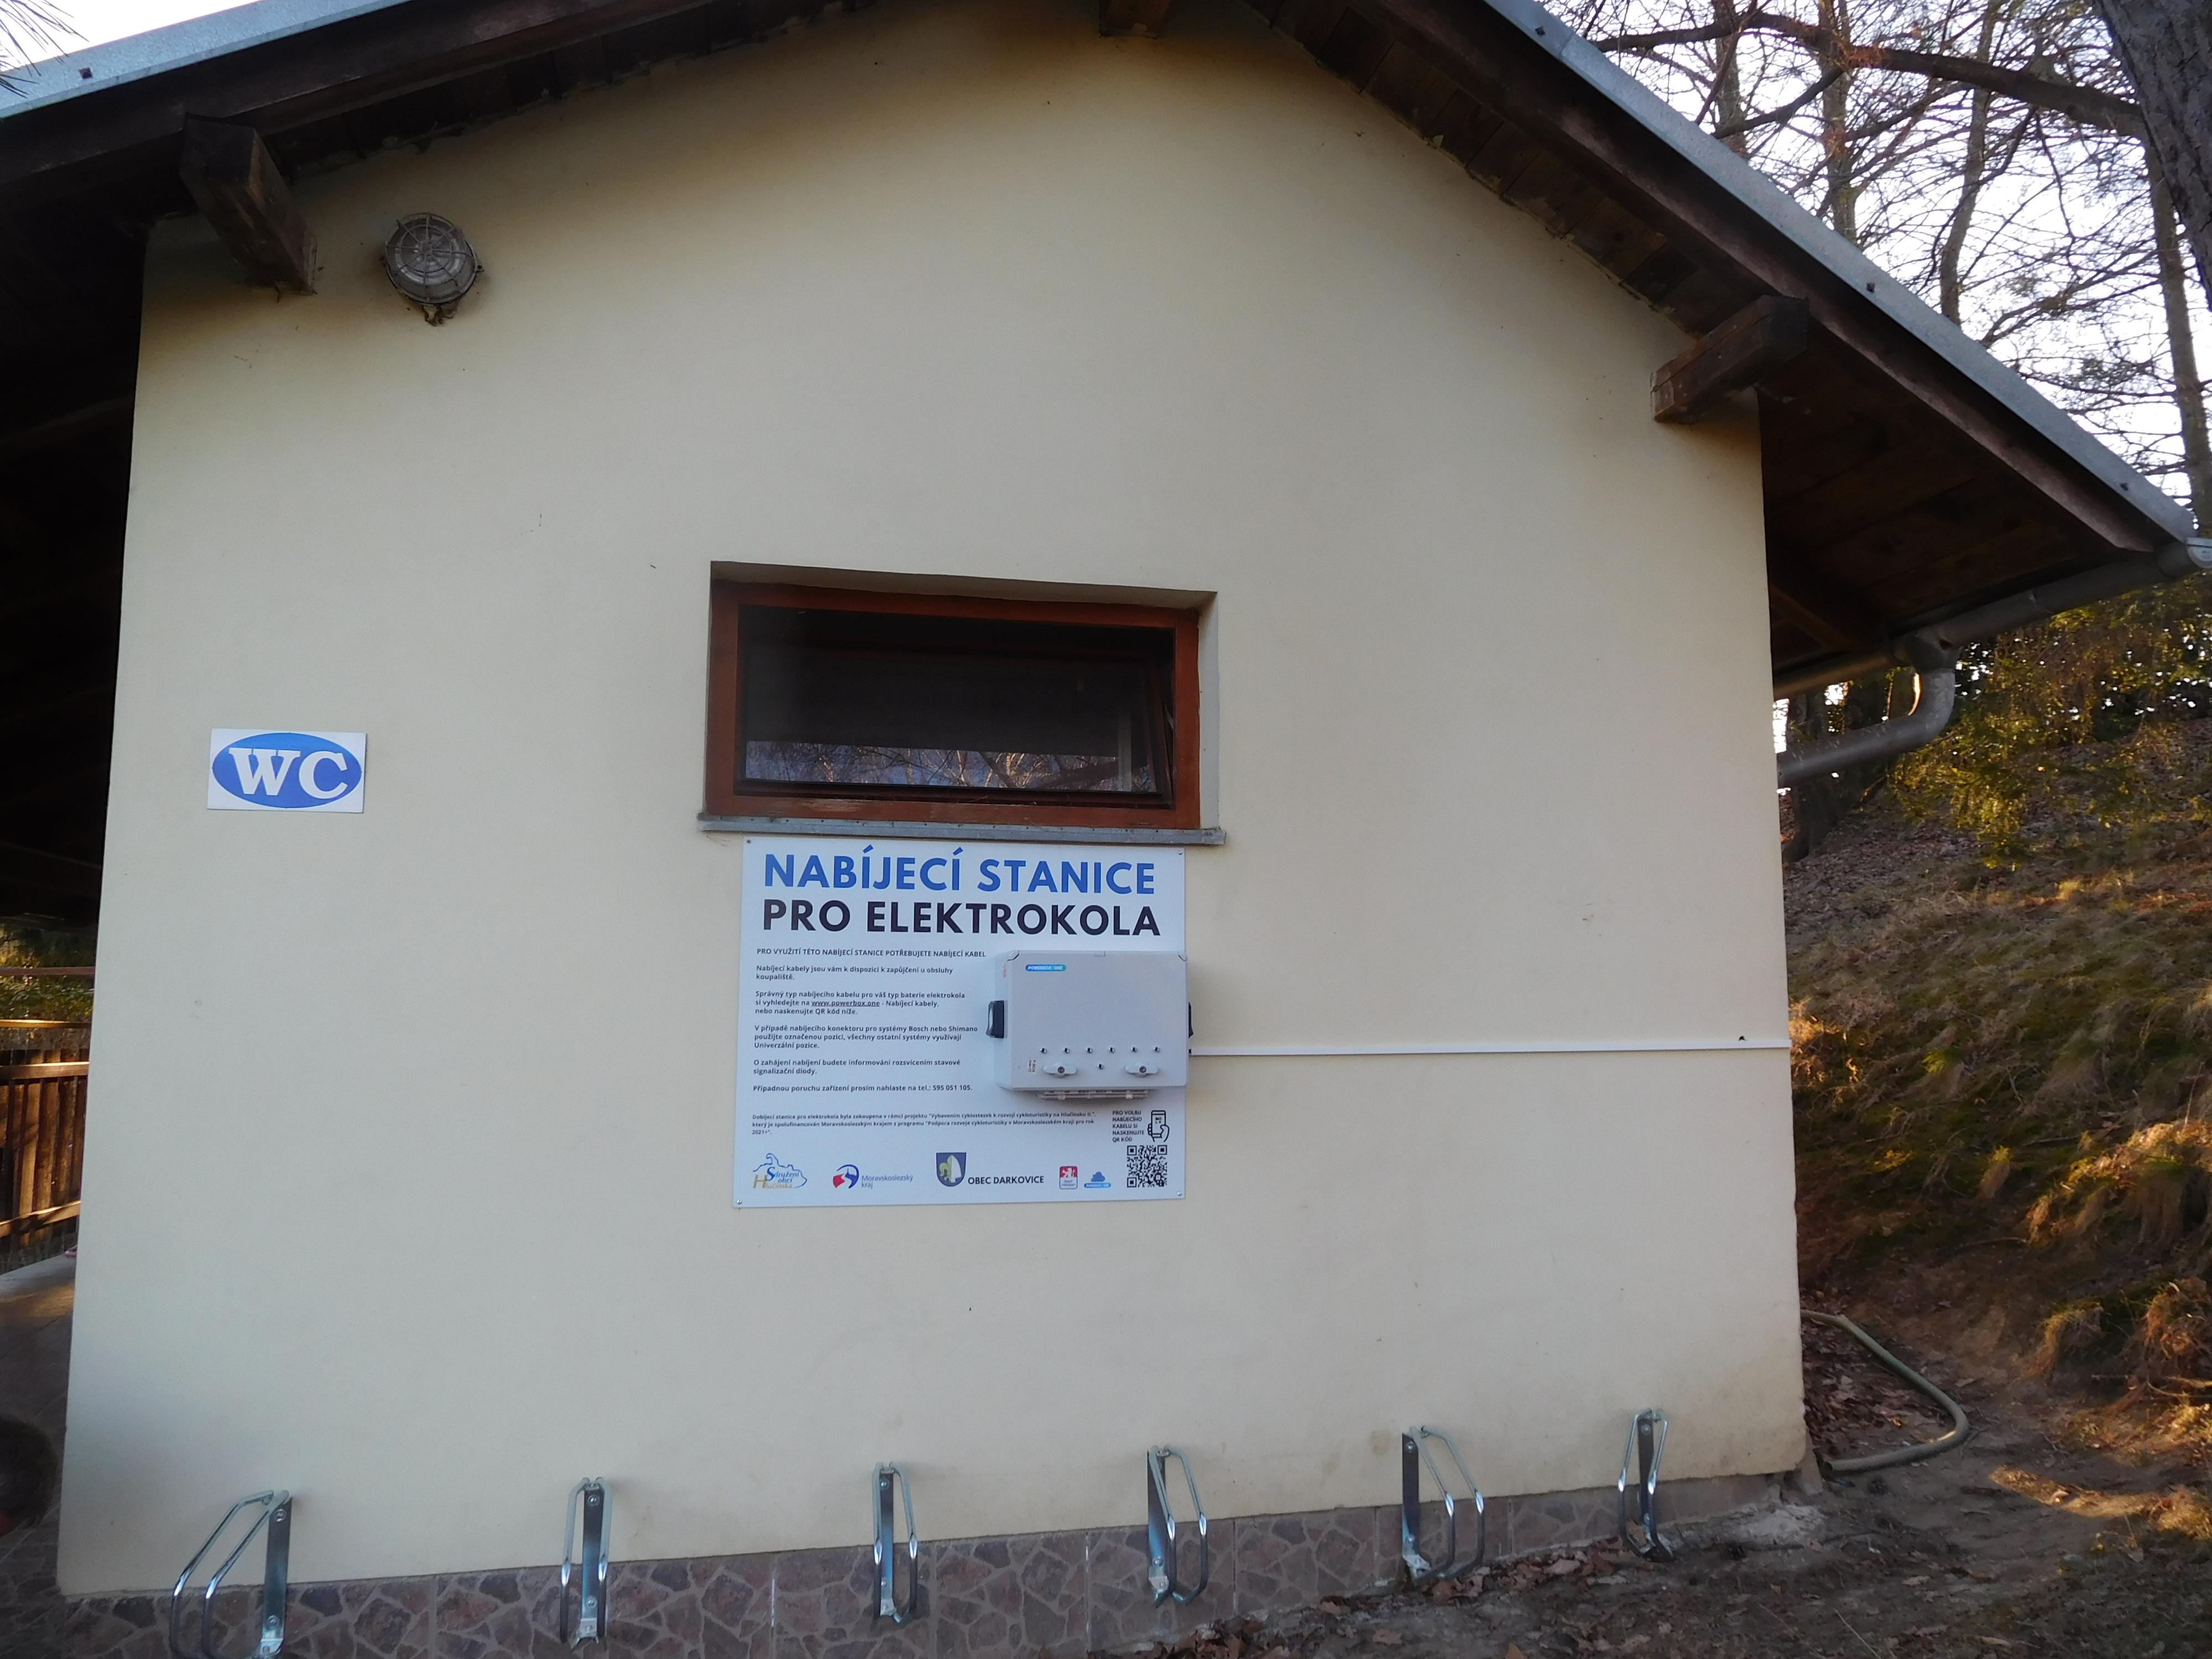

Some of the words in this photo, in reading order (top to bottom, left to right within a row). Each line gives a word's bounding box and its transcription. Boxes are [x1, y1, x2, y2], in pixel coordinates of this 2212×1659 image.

[228, 748, 348, 799] WC
[765, 844, 963, 890] NABÍJECÍ
[977, 859, 1155, 894] STANICE
[764, 899, 850, 931] PRO
[867, 901, 1160, 936] ELEKTROKOLA
